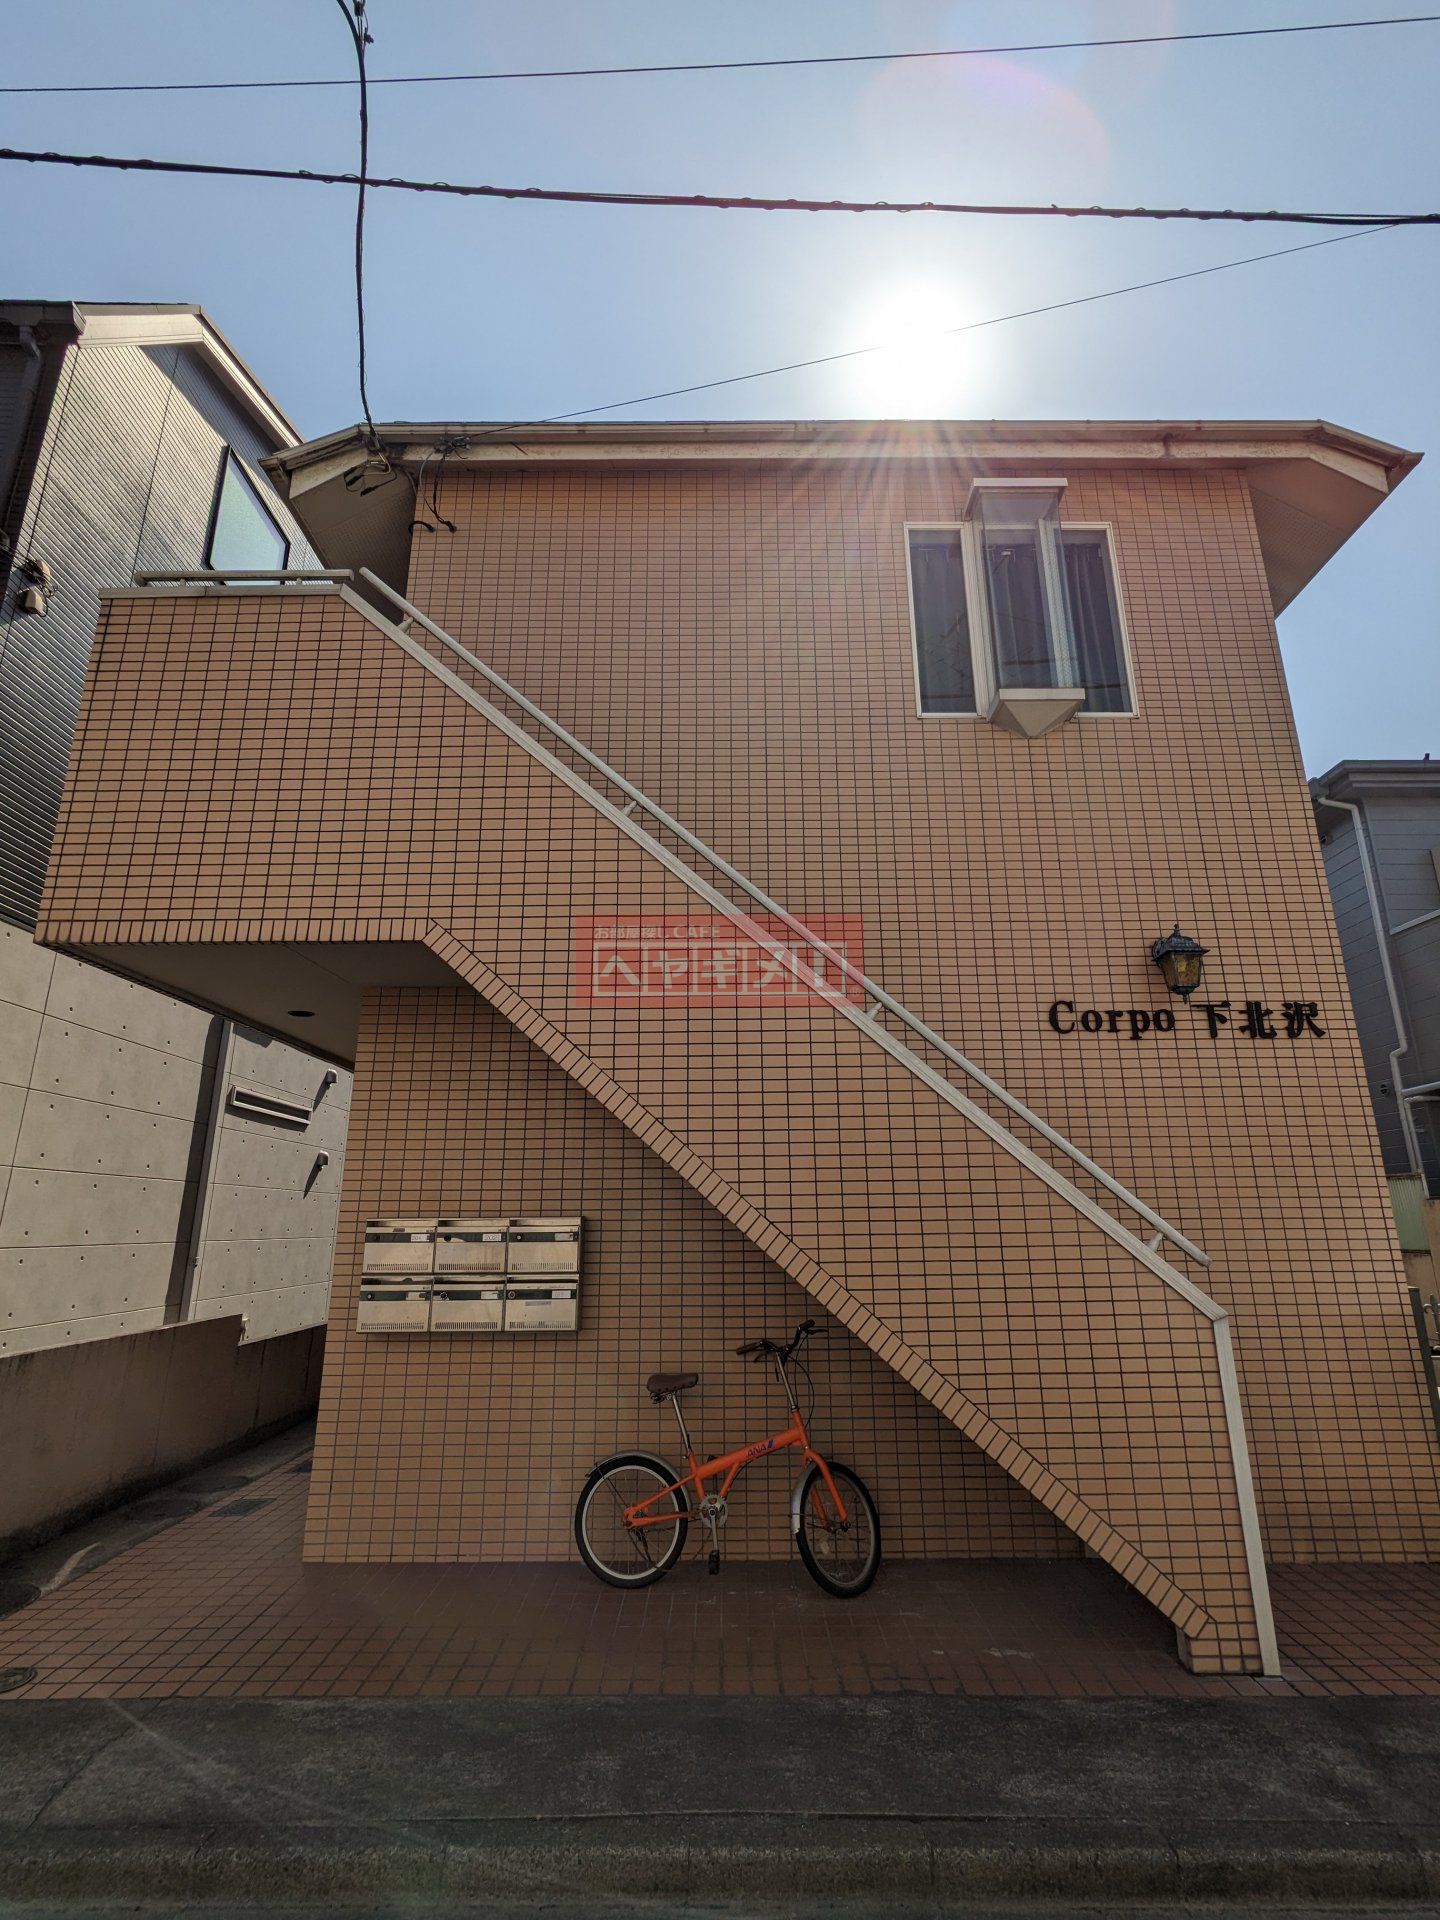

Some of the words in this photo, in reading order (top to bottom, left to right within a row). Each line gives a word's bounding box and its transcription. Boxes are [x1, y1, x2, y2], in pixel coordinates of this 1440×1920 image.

[1049, 1000, 1176, 1040] Corpo
[1191, 1000, 1326, 1039] 下北沢
